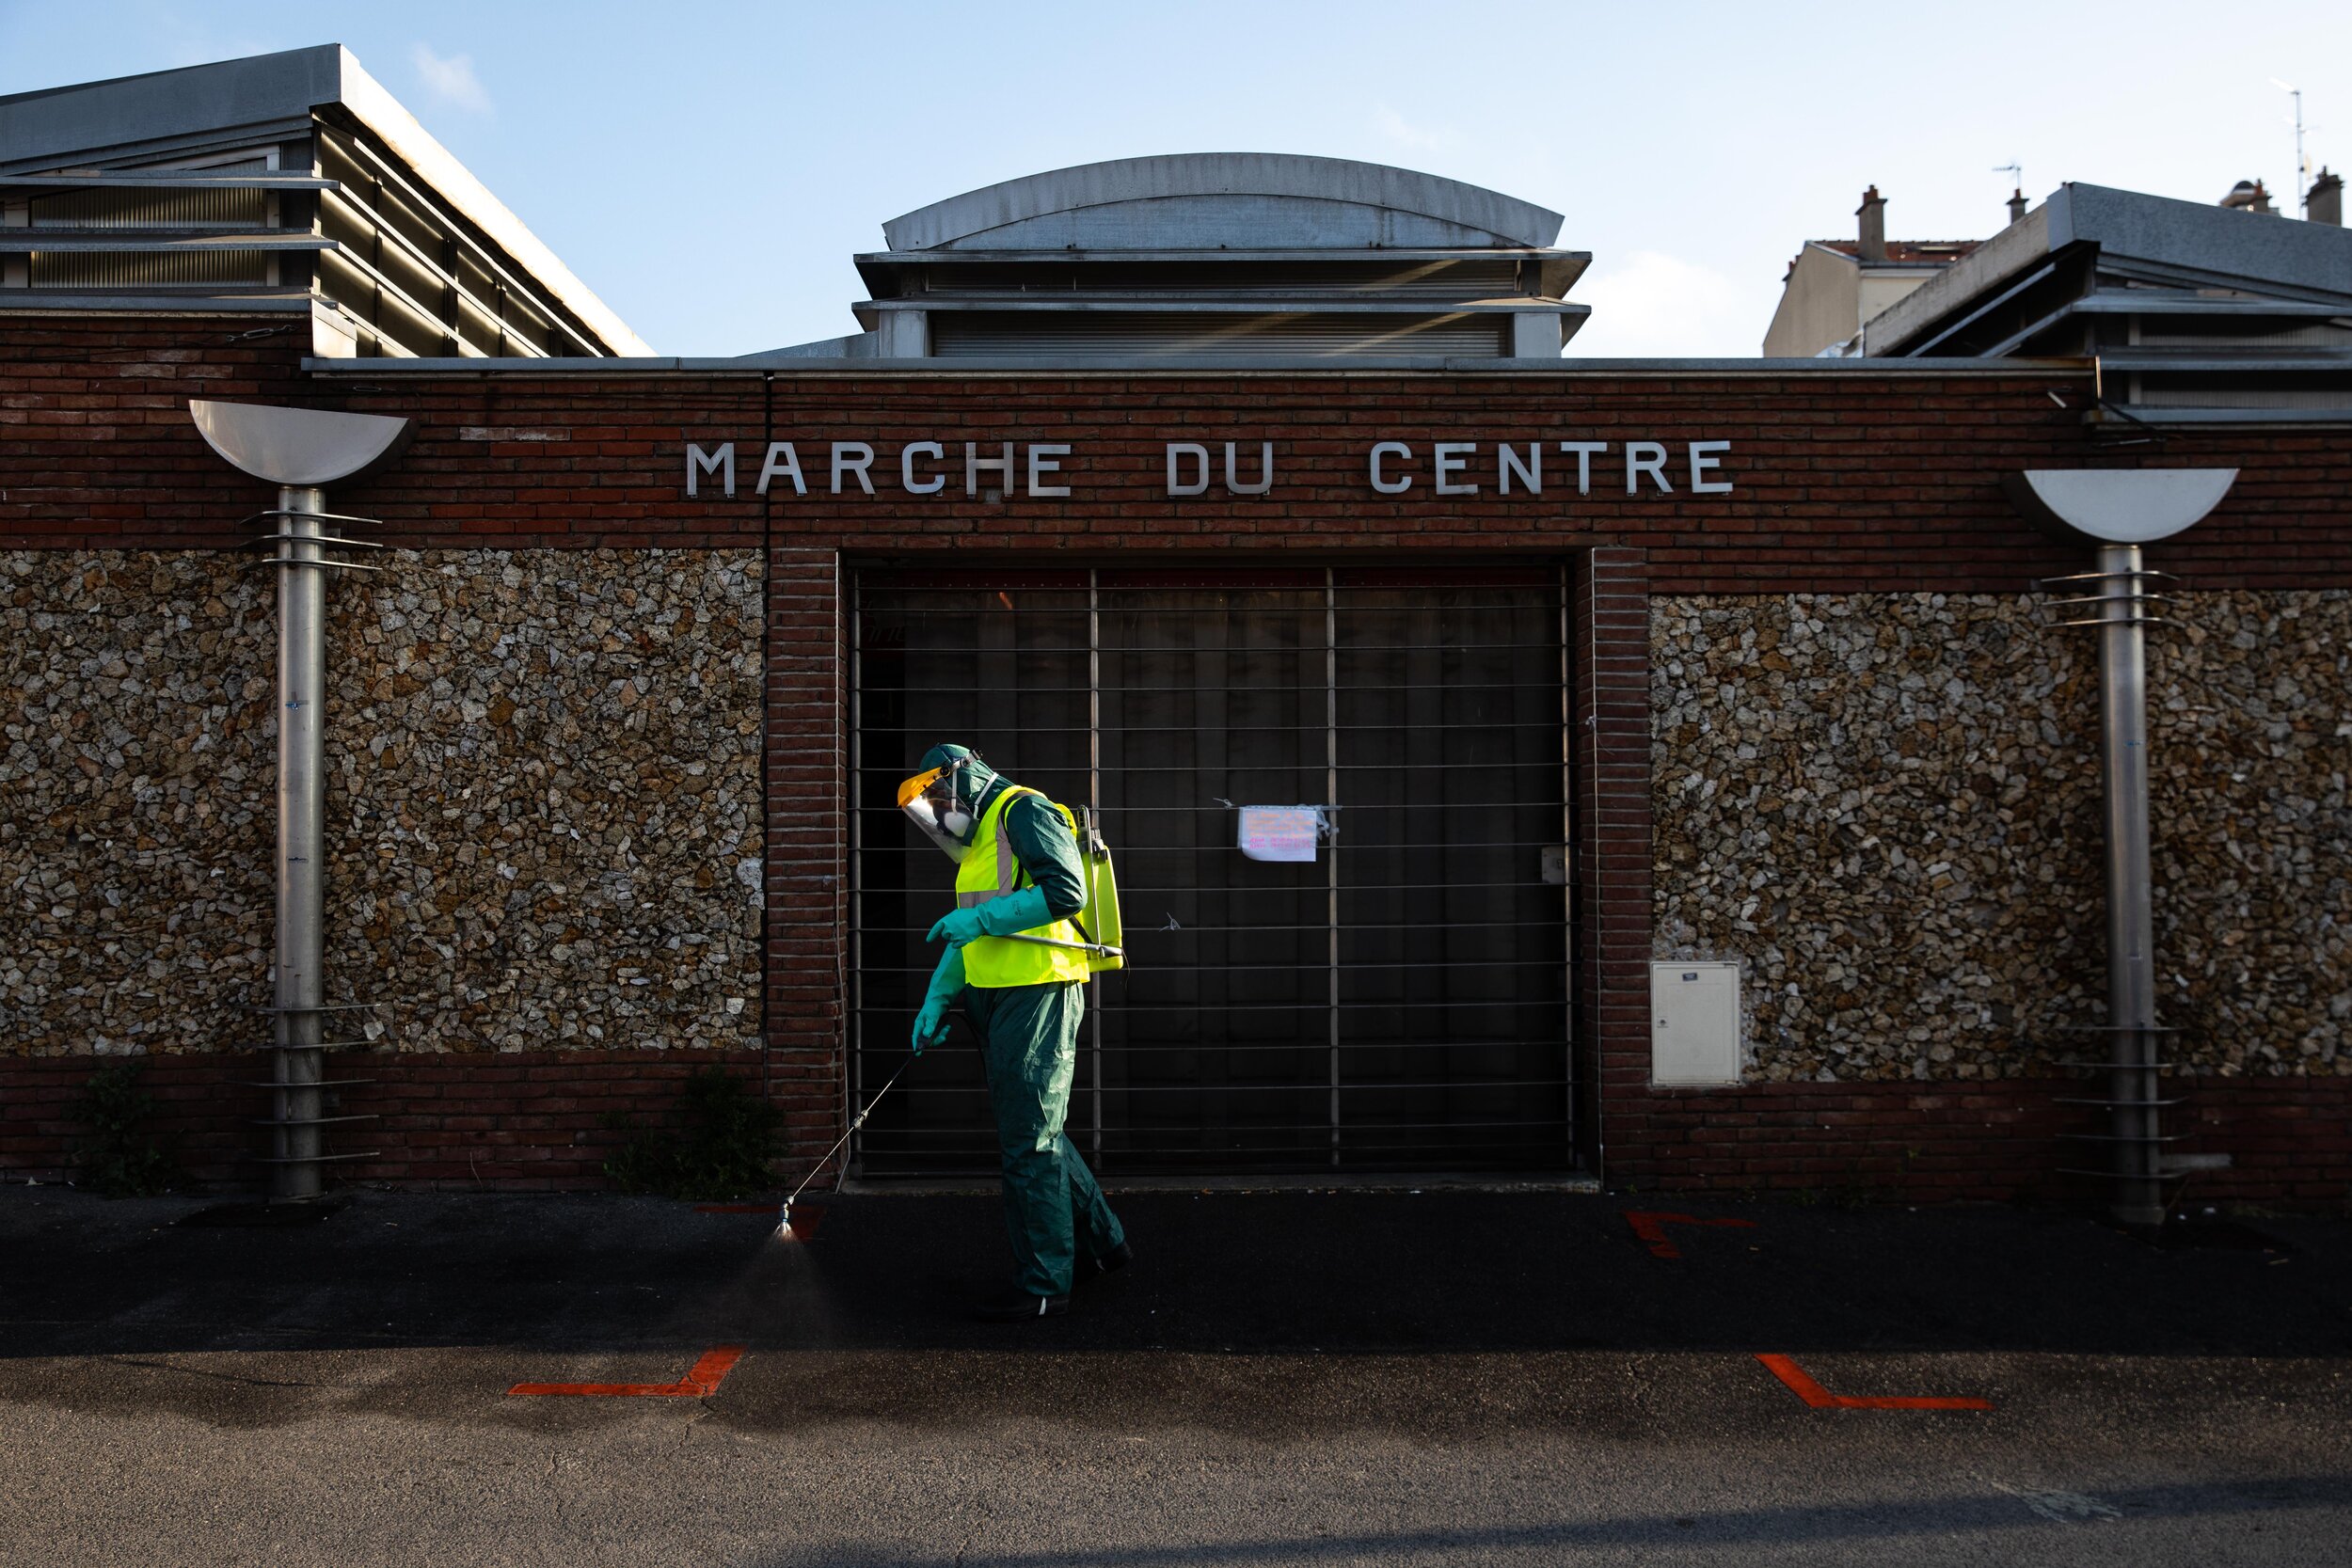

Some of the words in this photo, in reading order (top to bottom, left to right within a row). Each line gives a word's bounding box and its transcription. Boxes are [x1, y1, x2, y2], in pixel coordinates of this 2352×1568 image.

[686, 441, 1072, 497] MARCHE
[1167, 442, 1273, 496] DU
[1370, 440, 1734, 496] CENTRE
